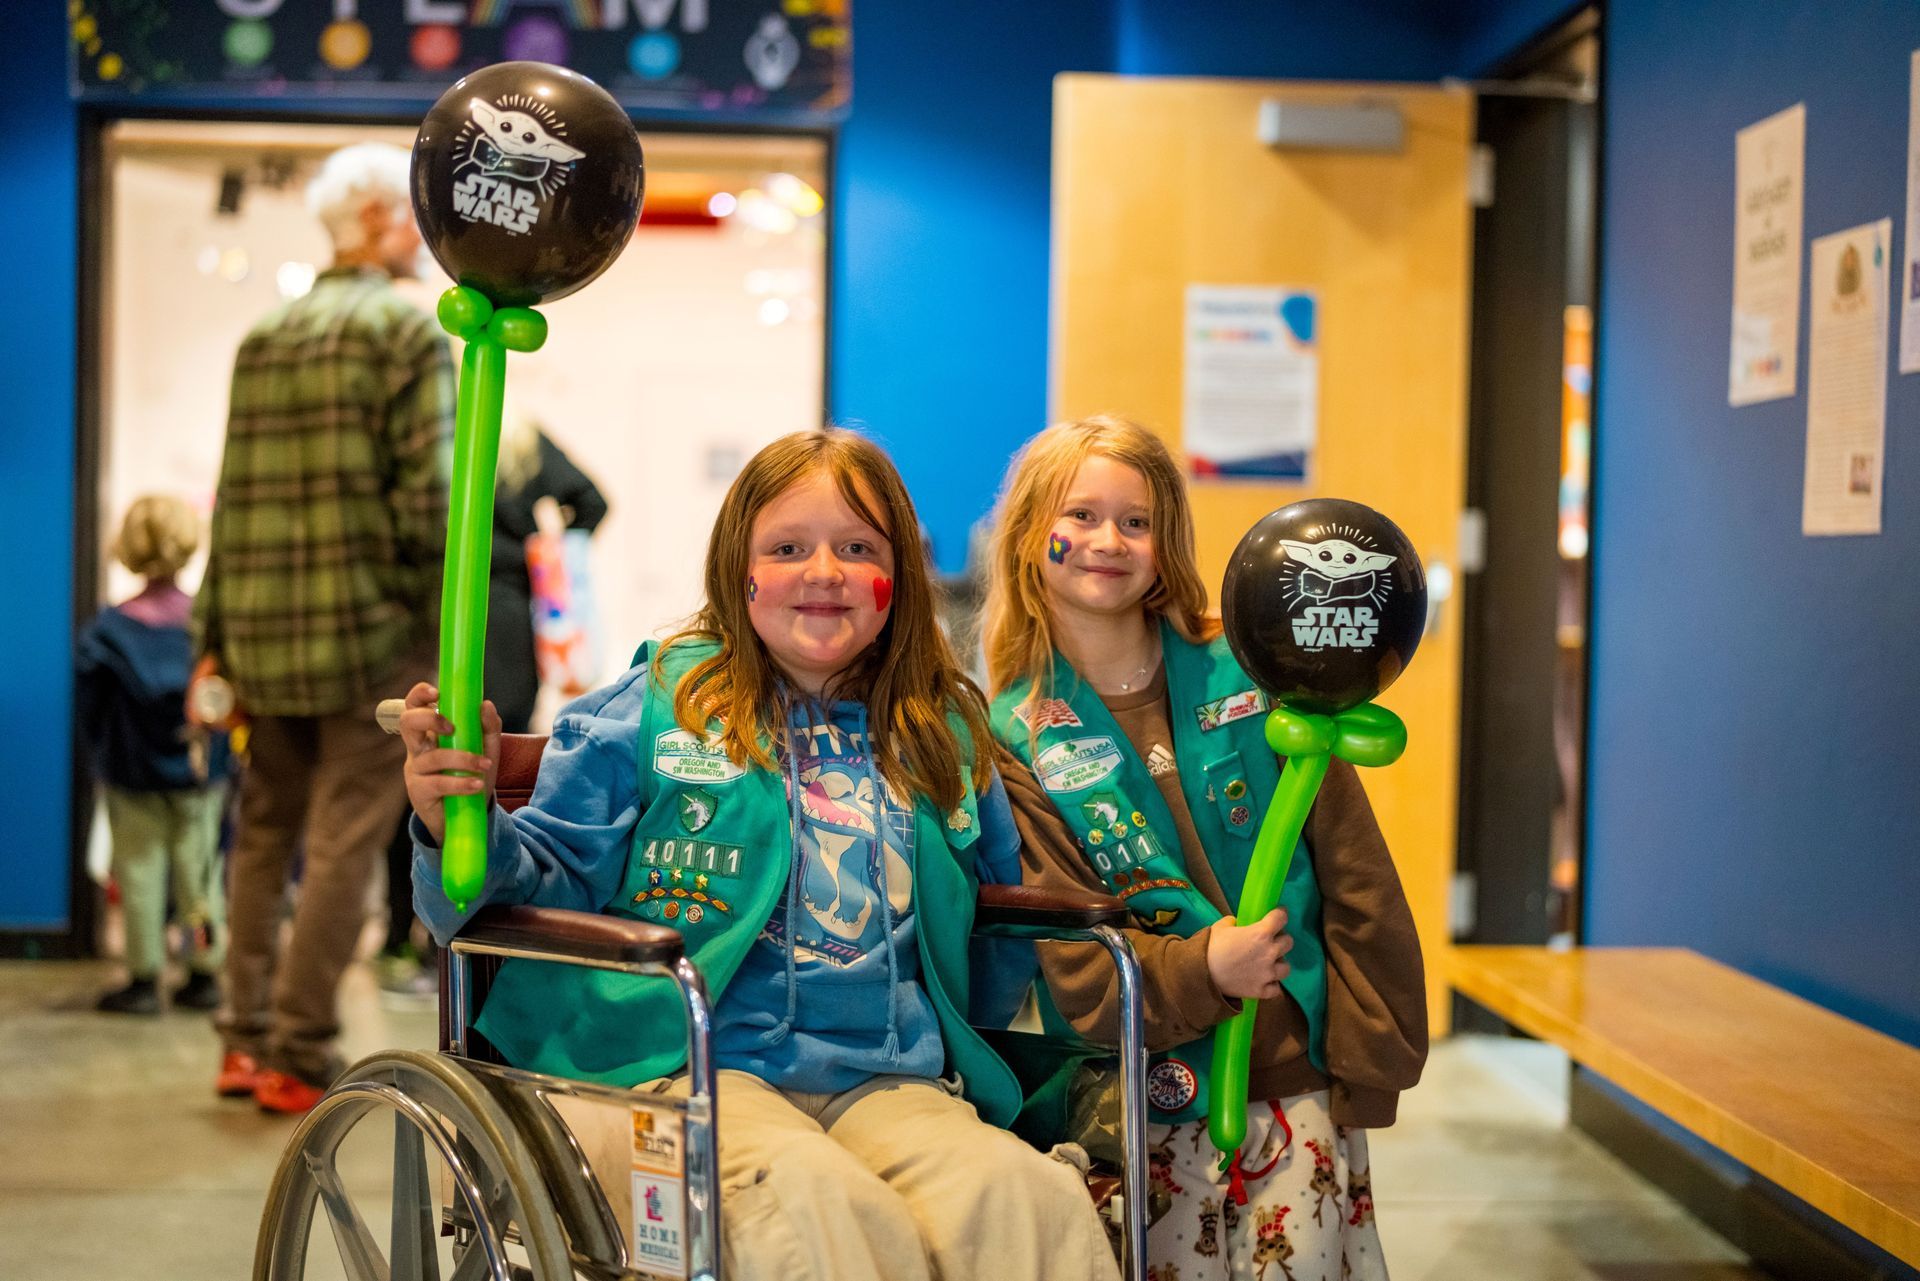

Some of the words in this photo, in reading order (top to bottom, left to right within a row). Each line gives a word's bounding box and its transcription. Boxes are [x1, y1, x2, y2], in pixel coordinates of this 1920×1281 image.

[454, 173, 540, 217] STAR
[453, 190, 538, 234] WARS
[1291, 606, 1379, 626] STAR
[1292, 627, 1379, 647] WARS
[660, 741, 681, 750] GIRL
[683, 742, 723, 755] SCOUTS
[1058, 747, 1093, 764] SCOUTS
[1093, 741, 1111, 754] USA
[679, 758, 705, 767] OREGON
[707, 760, 721, 769] AND
[684, 767, 725, 778] WASHINGTON
[644, 841, 739, 872] 40111
[1184, 1072, 1192, 1086] DAY
[639, 1223, 679, 1245] HOME
